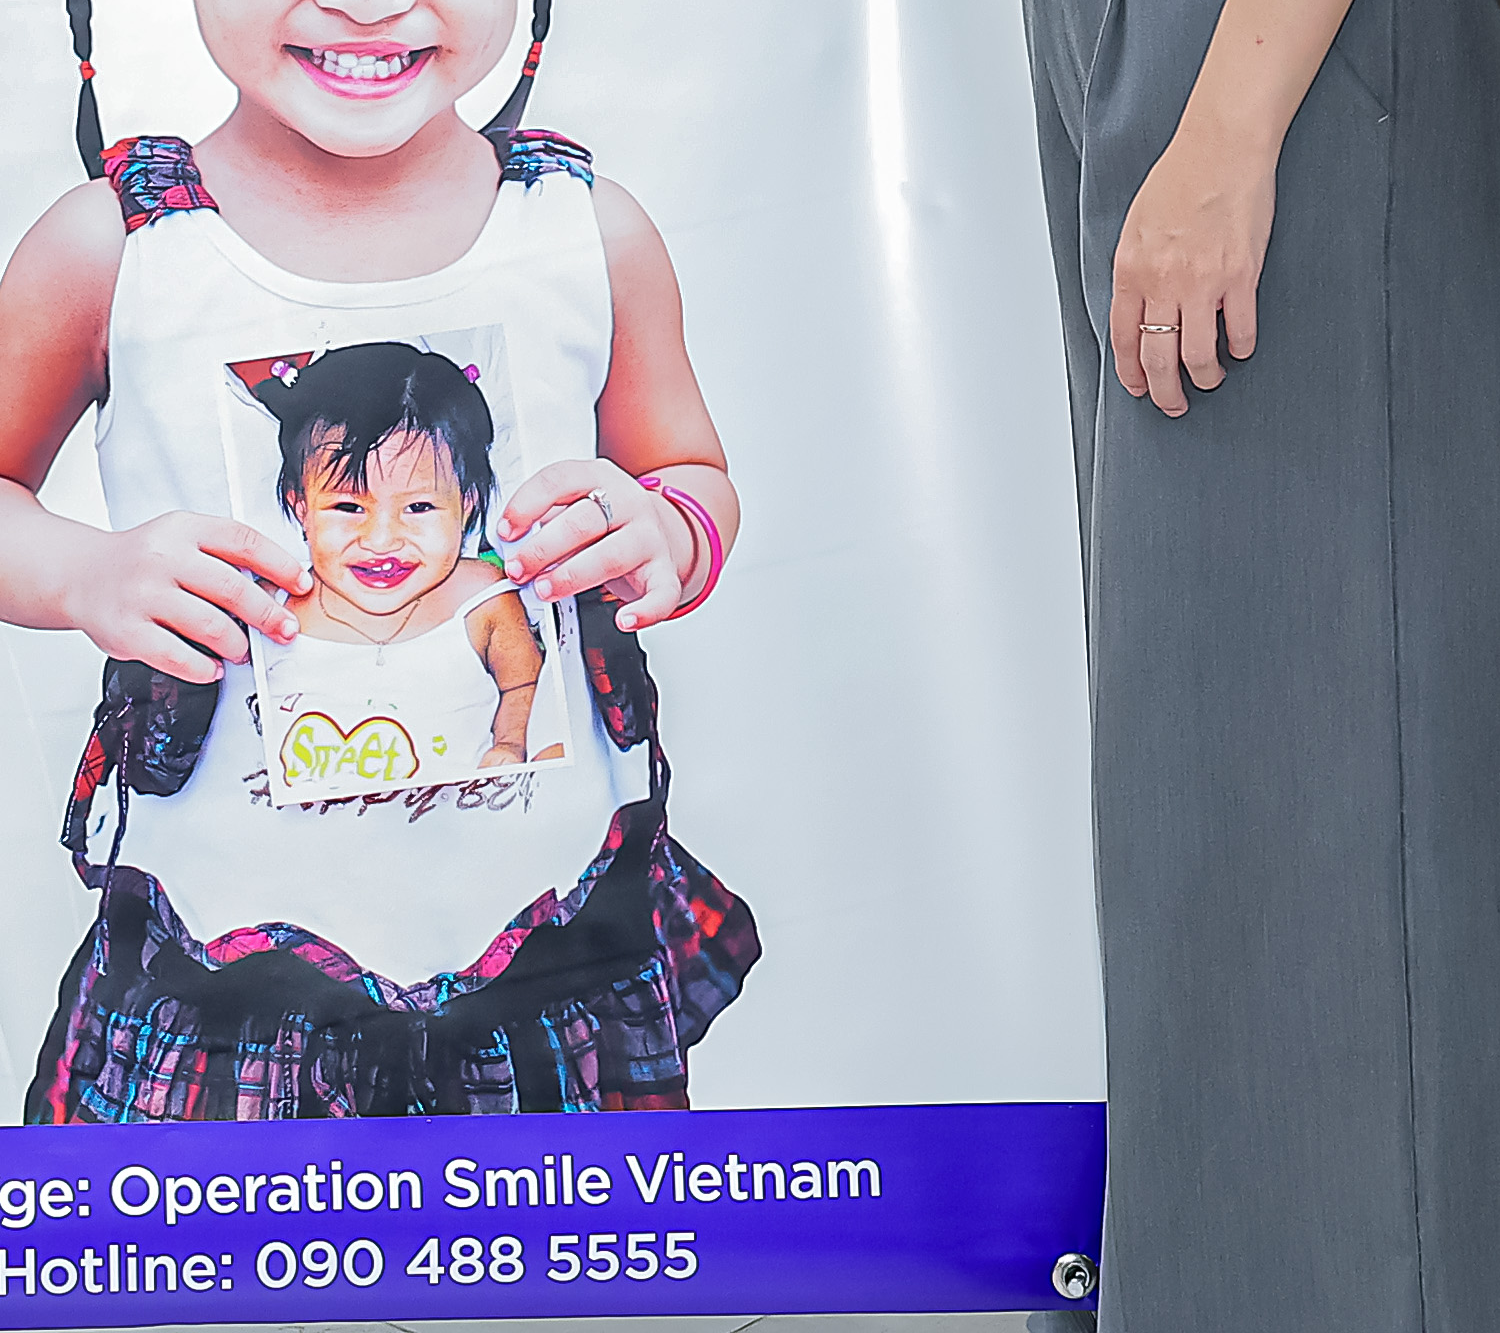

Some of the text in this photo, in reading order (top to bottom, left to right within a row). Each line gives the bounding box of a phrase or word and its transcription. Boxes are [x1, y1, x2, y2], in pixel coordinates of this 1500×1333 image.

[110, 1160, 423, 1225] Operation
[444, 1155, 612, 1208] Smile
[635, 1152, 882, 1203] Vietnam
[255, 1238, 385, 1289] 090
[405, 1235, 526, 1284] 488
[548, 1232, 698, 1281] 5555
